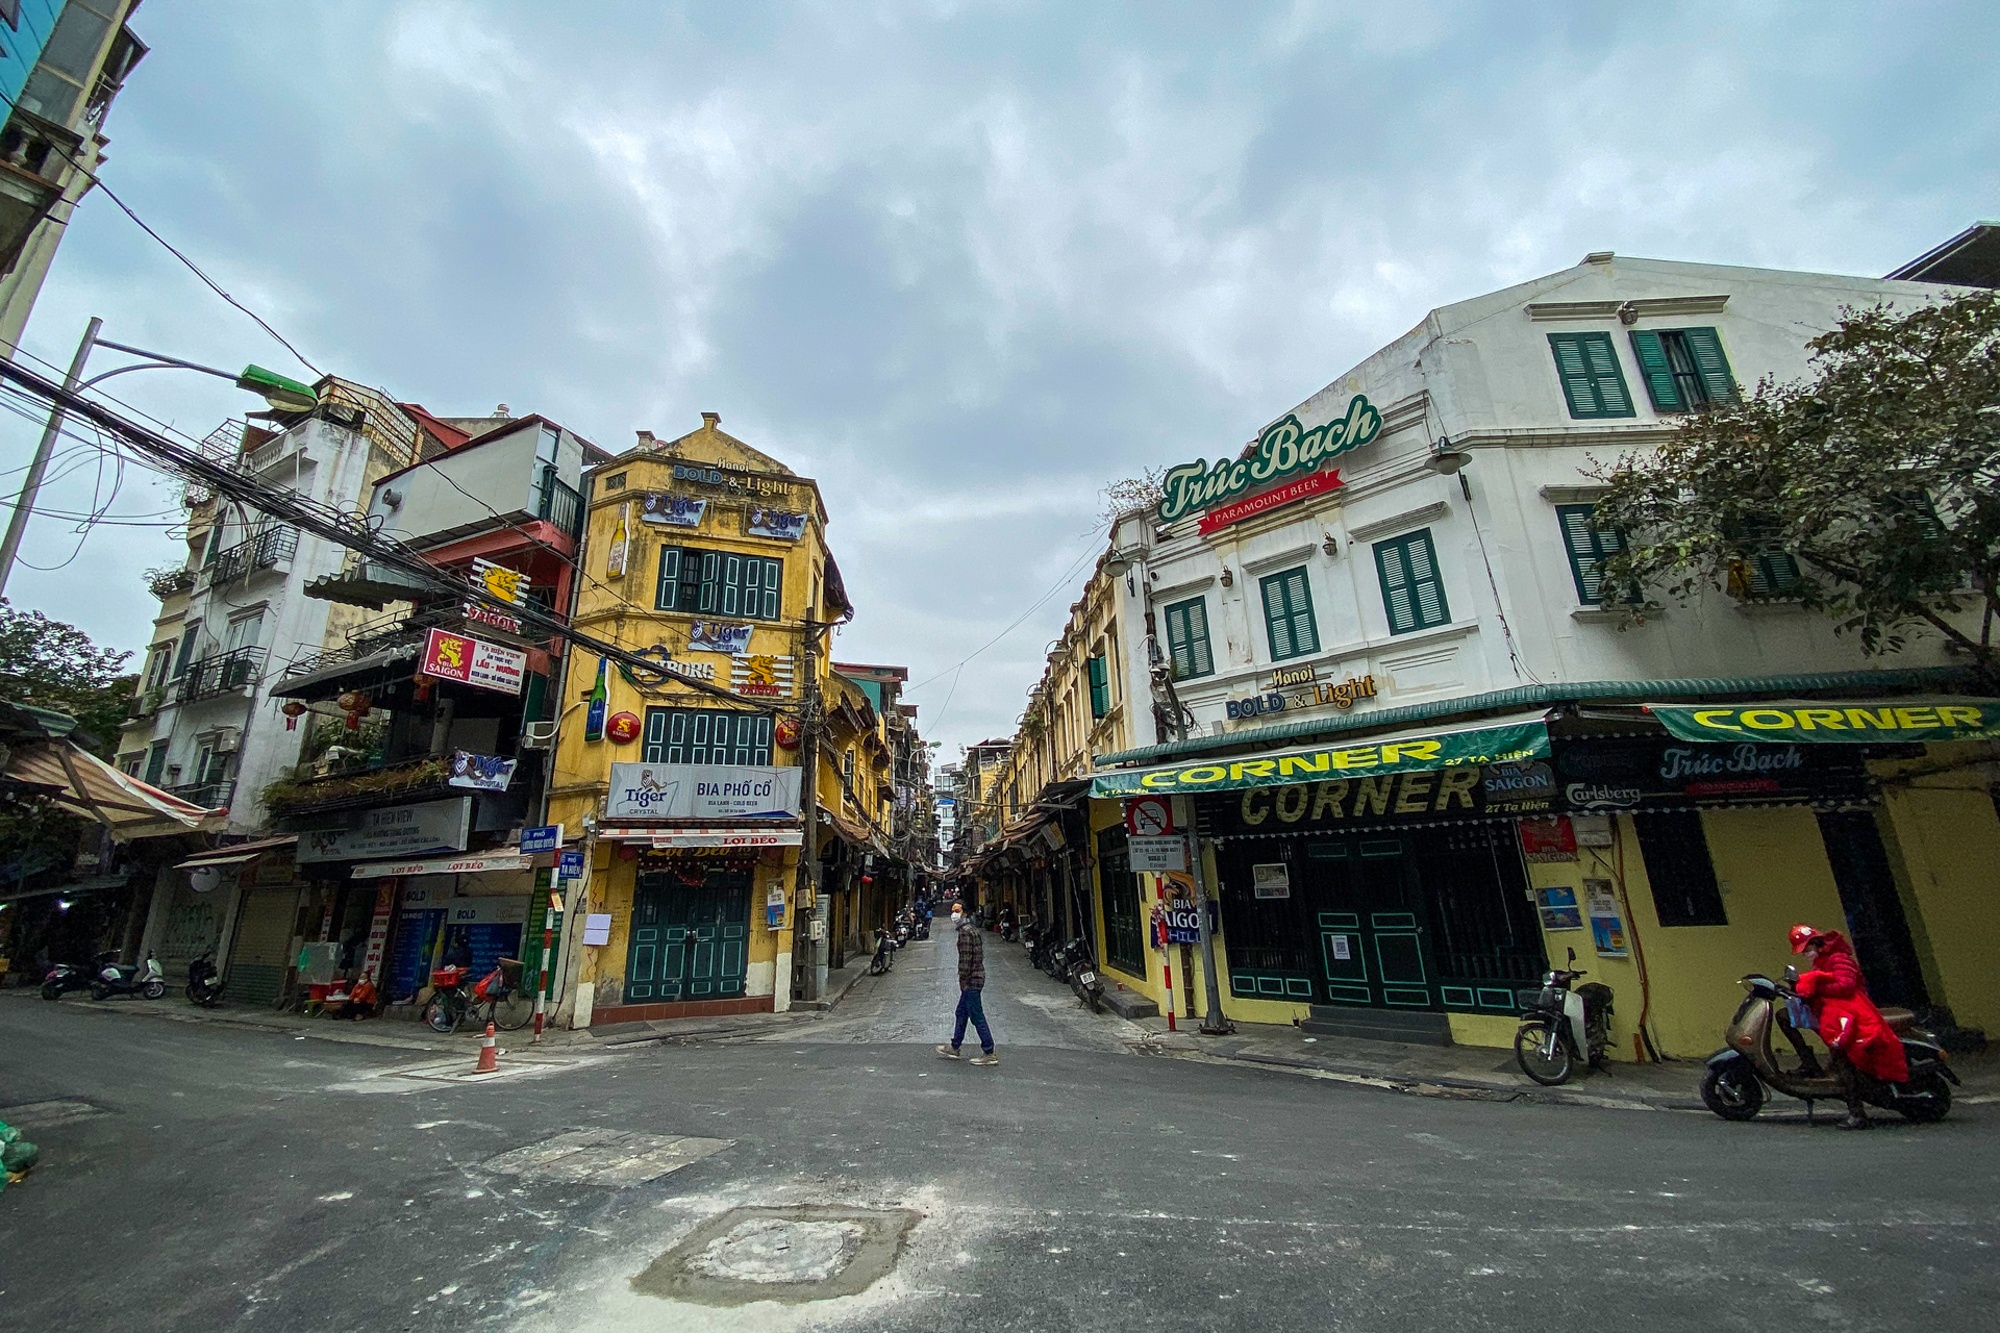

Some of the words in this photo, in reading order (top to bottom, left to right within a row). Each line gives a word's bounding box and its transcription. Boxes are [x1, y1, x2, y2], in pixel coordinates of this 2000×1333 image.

[717, 456, 750, 473] Hanoi
[1160, 461, 1246, 519] Trúc
[1251, 400, 1377, 479] Bạch
[673, 464, 723, 486] BOLD
[728, 476, 740, 487] &
[746, 476, 789, 498] Light
[1214, 488, 1288, 524] PARAMOUNT
[1290, 477, 1320, 497] BEER
[428, 663, 465, 679] SAIGON
[639, 659, 715, 681] BORG
[1271, 663, 1314, 688] Hanoi
[1225, 692, 1286, 720] BOLD
[1293, 693, 1306, 709] &
[1312, 674, 1378, 710] Light
[1693, 706, 1984, 731] CORNER
[1141, 740, 1443, 788] CORNER
[1444, 757, 1462, 767] 27
[1500, 767, 1523, 777] BIA
[696, 782, 719, 796] BIA
[723, 779, 753, 797] PHỐ
[753, 778, 773, 797] CỔ
[1484, 775, 1549, 791] SAIGON
[624, 786, 668, 808] Tiger
[1241, 764, 1481, 826] CORNER
[1566, 782, 1641, 807] Carlsberg
[1484, 803, 1501, 814] 27
[532, 830, 546, 838] PHỐ
[1525, 851, 1577, 862] SAIGON
[405, 890, 427, 902] BOLD
[1173, 898, 1192, 909] BIA
[456, 909, 477, 920] BOLD
[1151, 911, 1214, 931] AIGO
